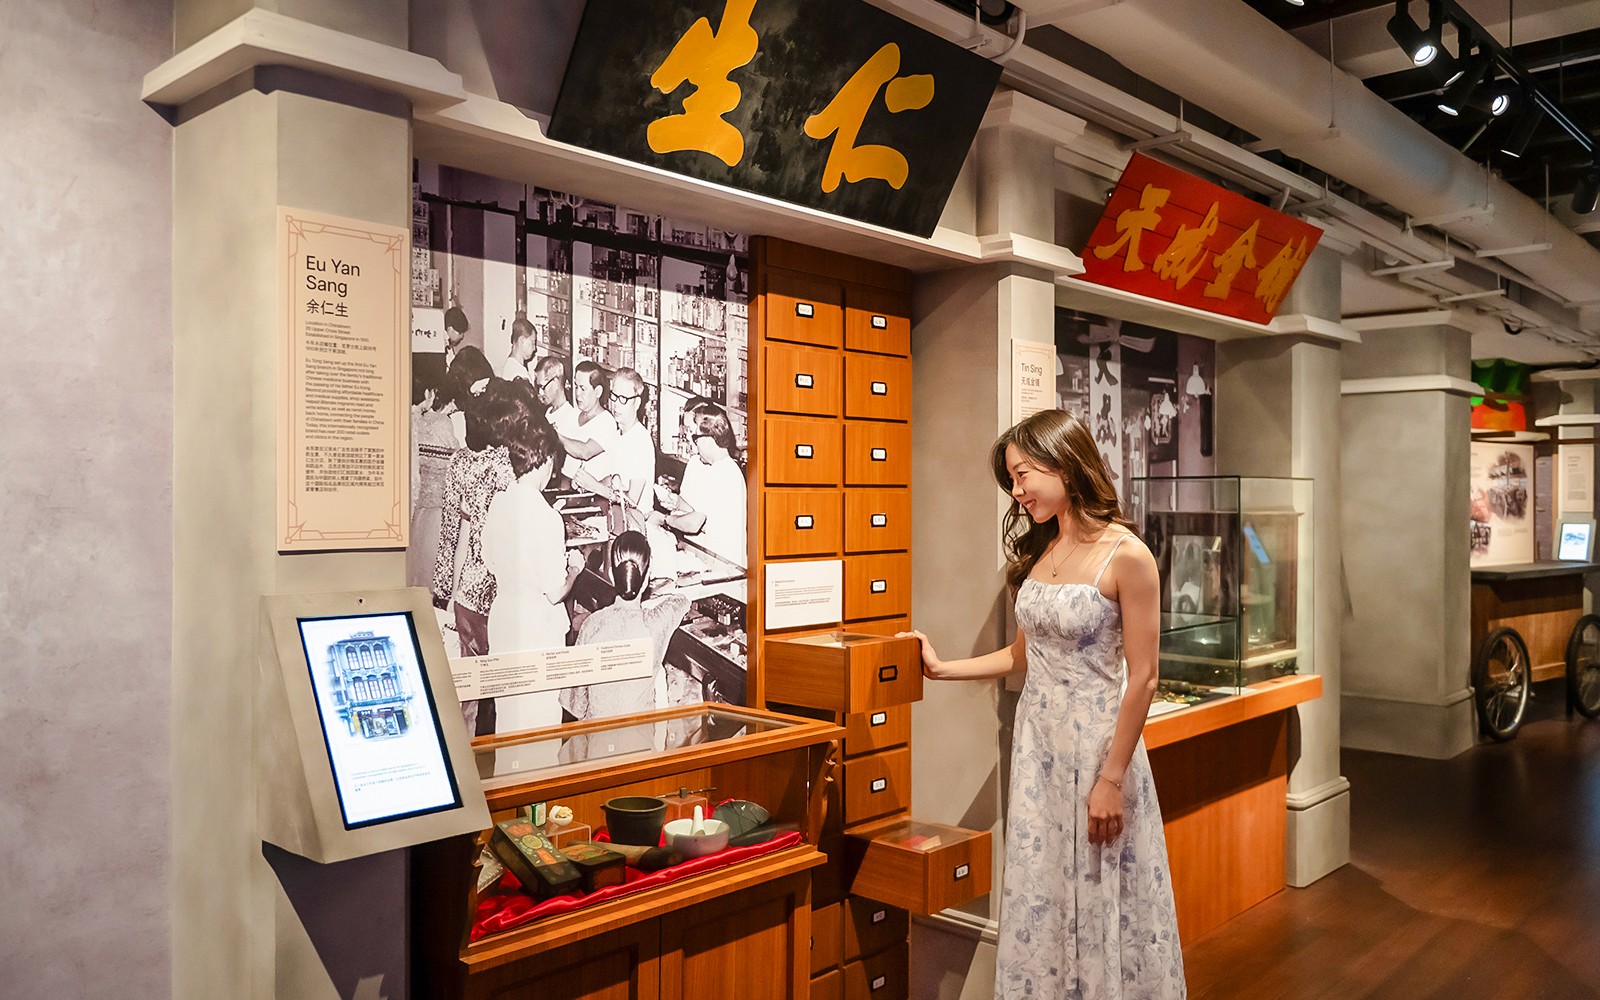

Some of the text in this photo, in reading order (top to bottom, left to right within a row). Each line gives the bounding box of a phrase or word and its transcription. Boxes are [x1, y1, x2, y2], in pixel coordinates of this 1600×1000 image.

[307, 256, 360, 276] Eu Yan
[306, 275, 347, 297] Sang
[307, 299, 348, 317] 余仁生
[1030, 364, 1042, 376] Sing
